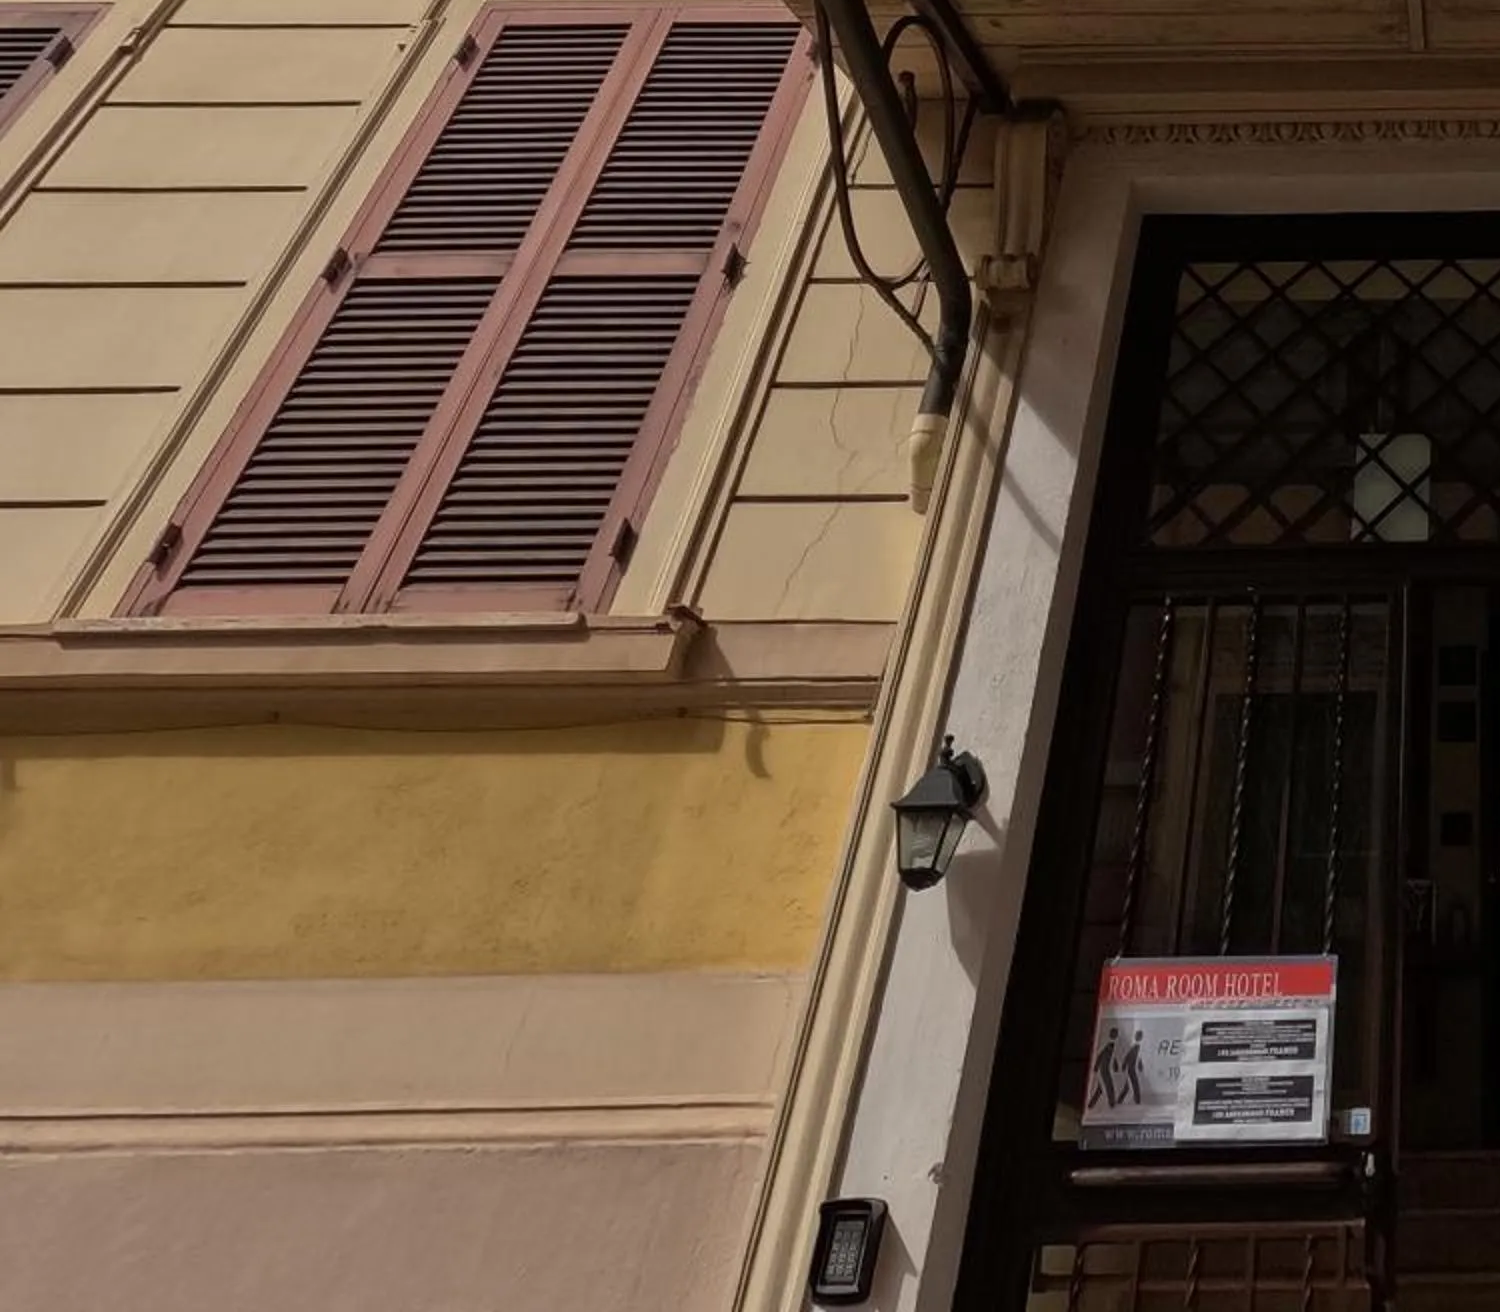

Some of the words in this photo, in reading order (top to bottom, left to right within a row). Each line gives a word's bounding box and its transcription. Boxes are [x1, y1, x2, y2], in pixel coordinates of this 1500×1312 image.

[1108, 975, 1158, 1001] ROMA
[1165, 974, 1219, 999] ROOM
[1224, 973, 1283, 997] HOTEL
